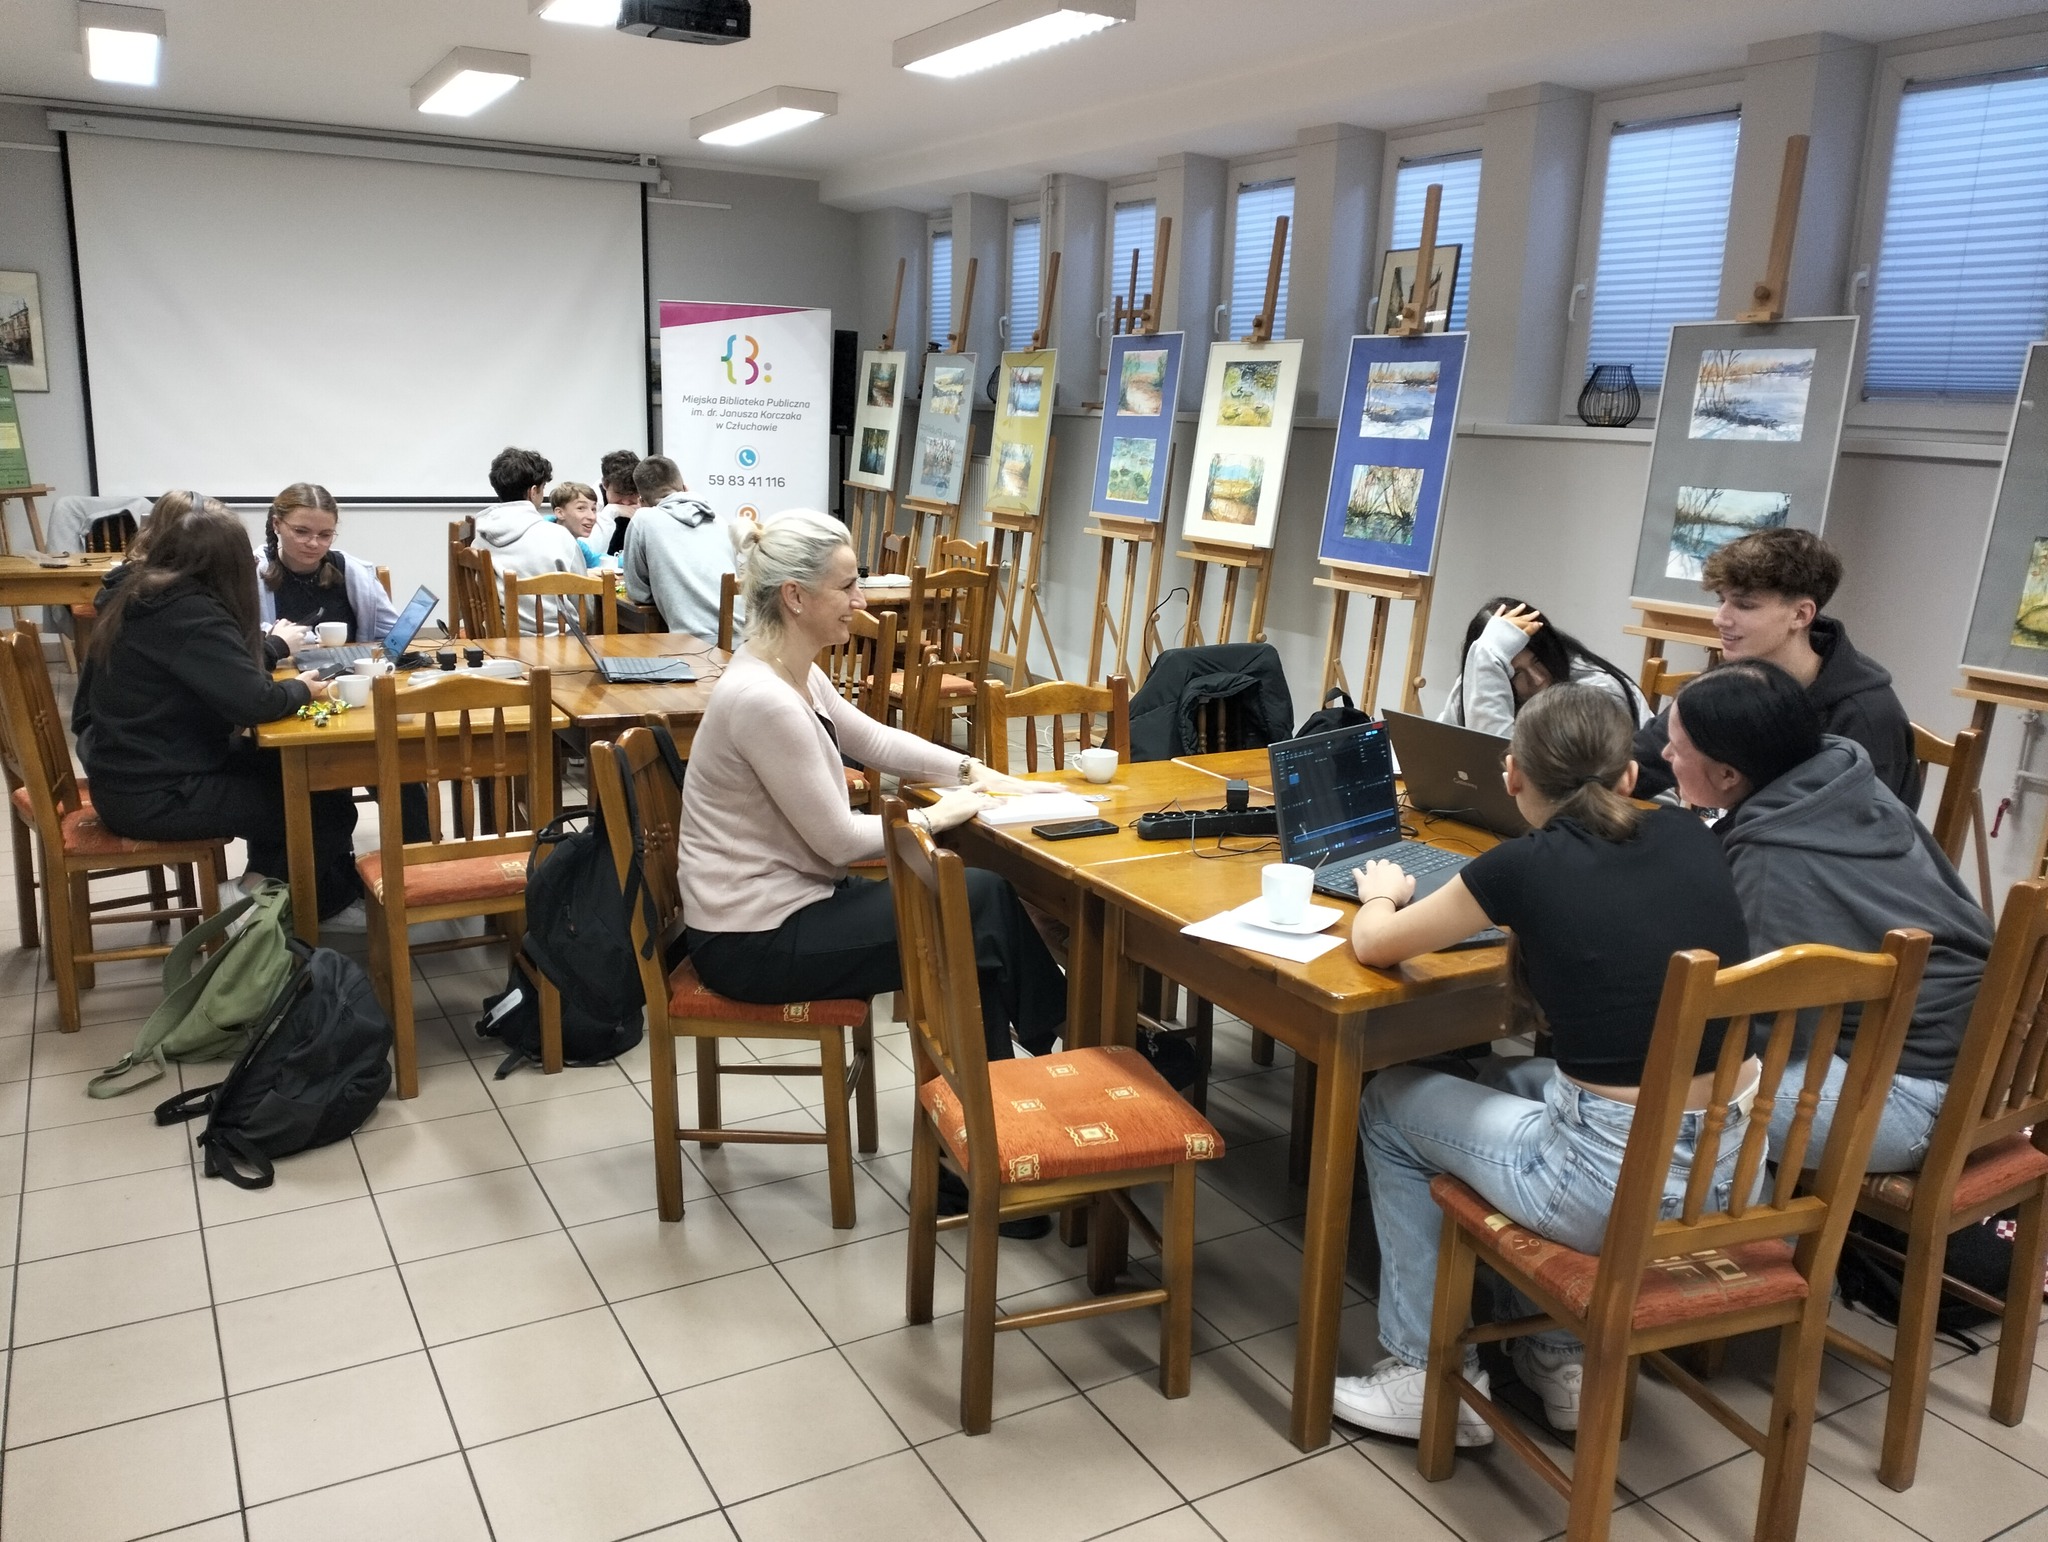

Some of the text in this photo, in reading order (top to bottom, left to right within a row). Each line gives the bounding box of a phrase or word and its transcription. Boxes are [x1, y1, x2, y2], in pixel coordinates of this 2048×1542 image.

[682, 394, 811, 408] Miejska Biblioteka Publiczna
[691, 408, 802, 420] im. dr. Janusza Korczaka
[715, 421, 778, 431] w Człuchowie
[708, 474, 786, 488] 59 83 41 116
